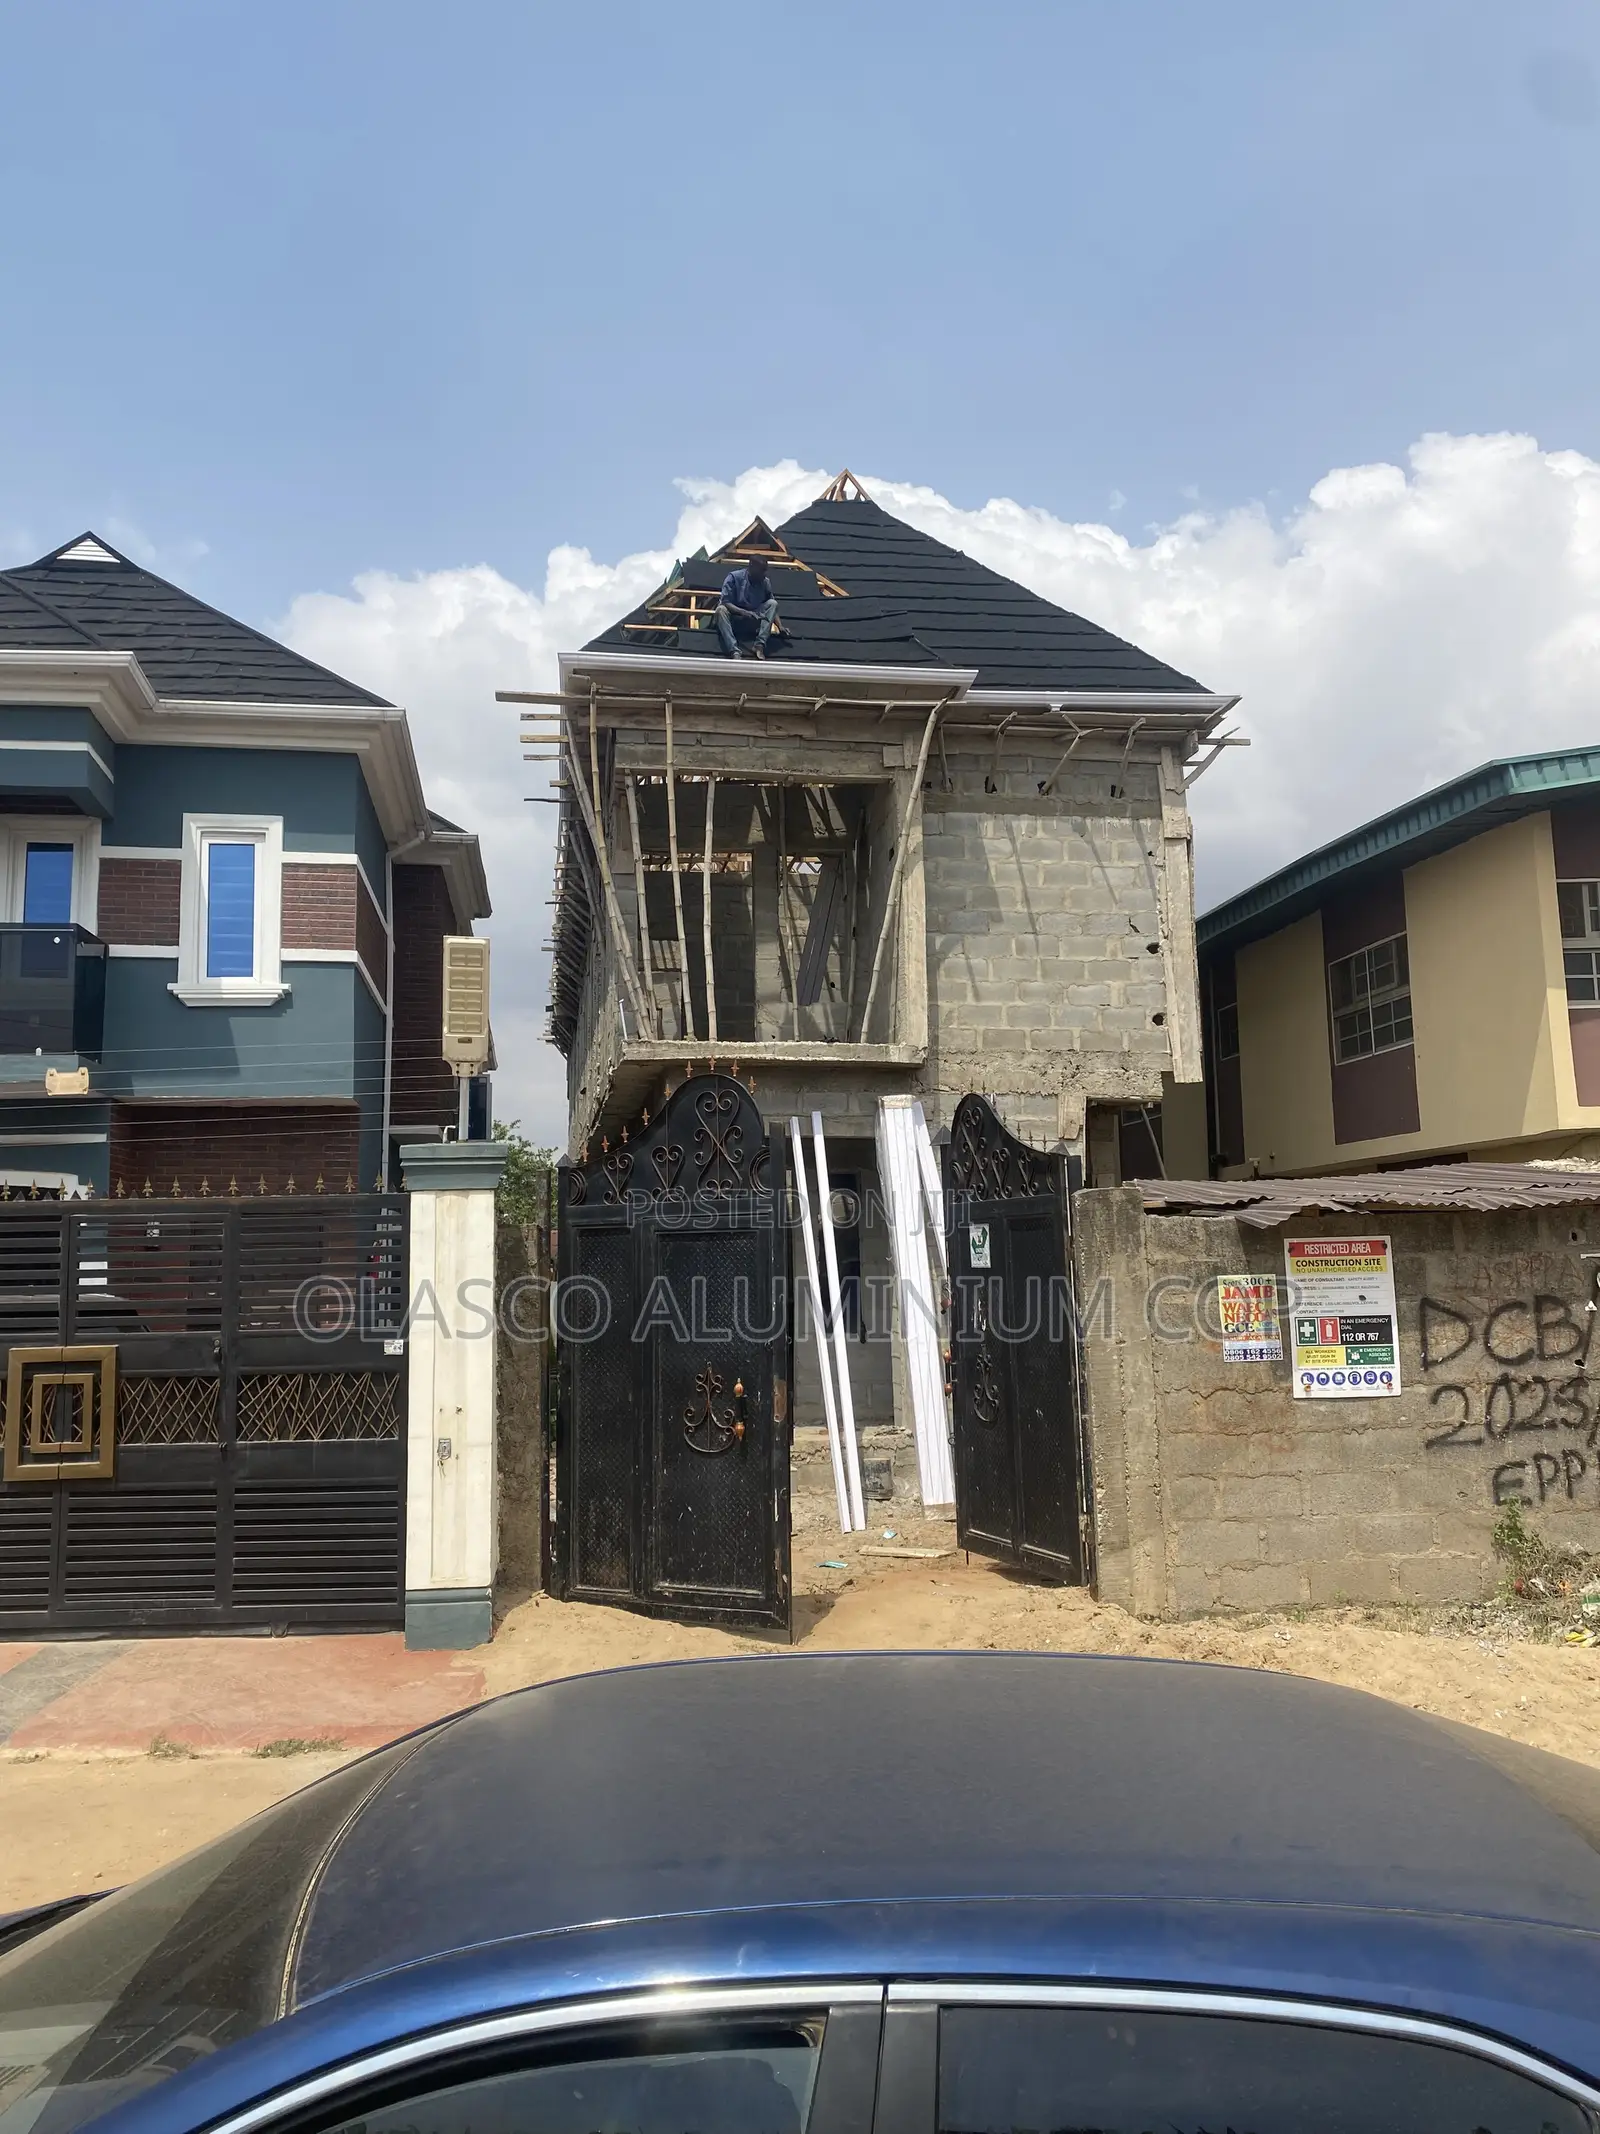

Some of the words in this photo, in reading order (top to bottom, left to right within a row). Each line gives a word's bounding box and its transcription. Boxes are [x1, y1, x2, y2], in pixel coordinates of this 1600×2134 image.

[1304, 1244, 1349, 1254] RESTRICTED
[1351, 1243, 1371, 1254] AREA
[1295, 1259, 1362, 1268] CONSTRUCTION
[1364, 1258, 1382, 1266] SITE
[1221, 1285, 1275, 1299] JAMB
[1222, 1302, 1264, 1313] WAEC
[1224, 1322, 1255, 1333] GCE
[1341, 1332, 1355, 1342] 112
[1355, 1332, 1366, 1341] OR
[1366, 1332, 1379, 1341] 767
